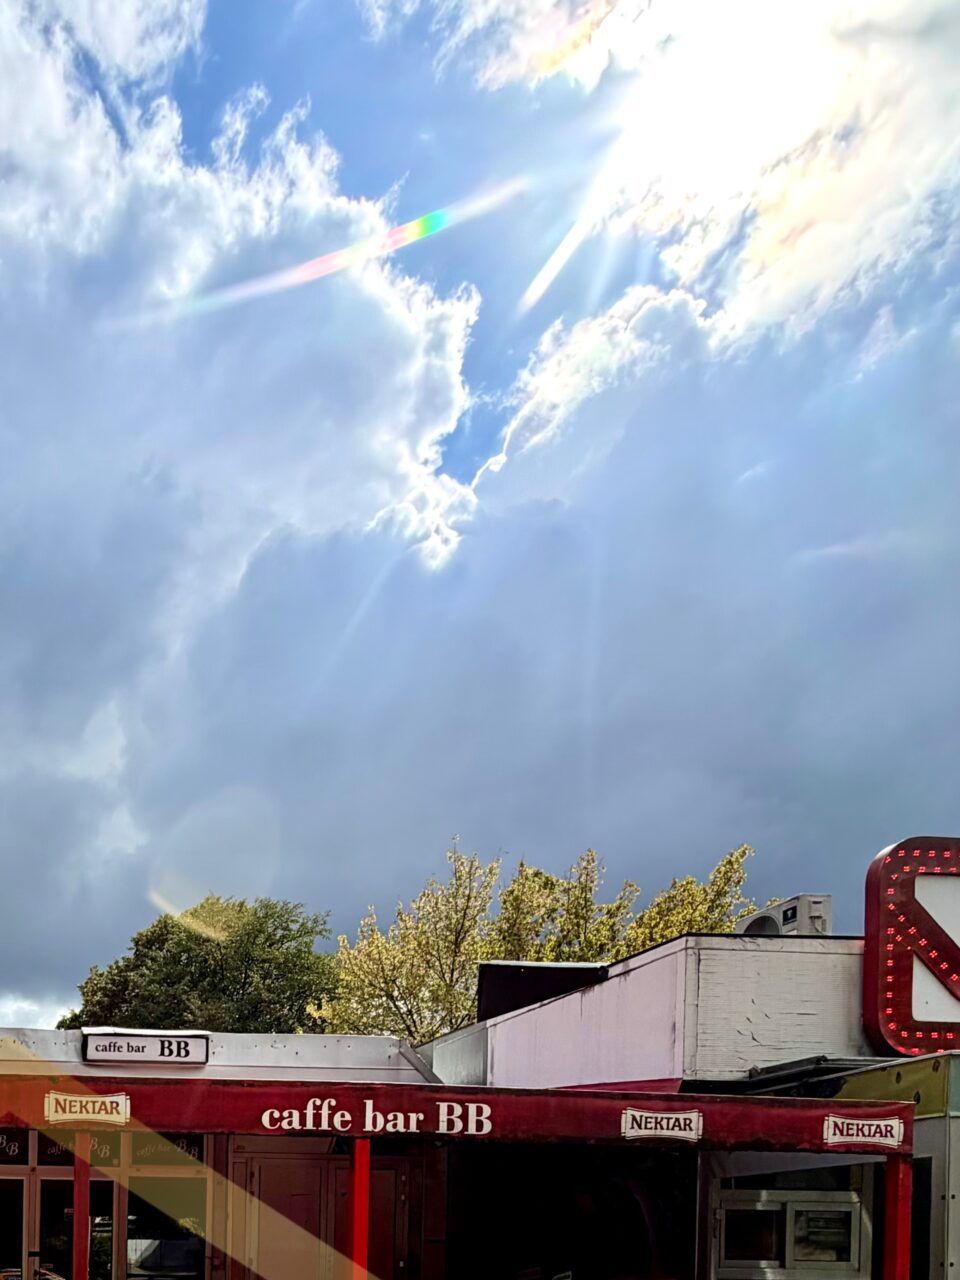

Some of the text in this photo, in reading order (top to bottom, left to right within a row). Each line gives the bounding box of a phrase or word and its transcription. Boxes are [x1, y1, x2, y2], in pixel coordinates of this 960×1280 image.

[94, 1039, 191, 1059] caffe bar BB
[53, 1097, 121, 1115] NEKTAR
[261, 1097, 493, 1135] caffe bar BB
[629, 1113, 694, 1132] NEKTAR
[832, 1120, 895, 1139] NEKTAR
